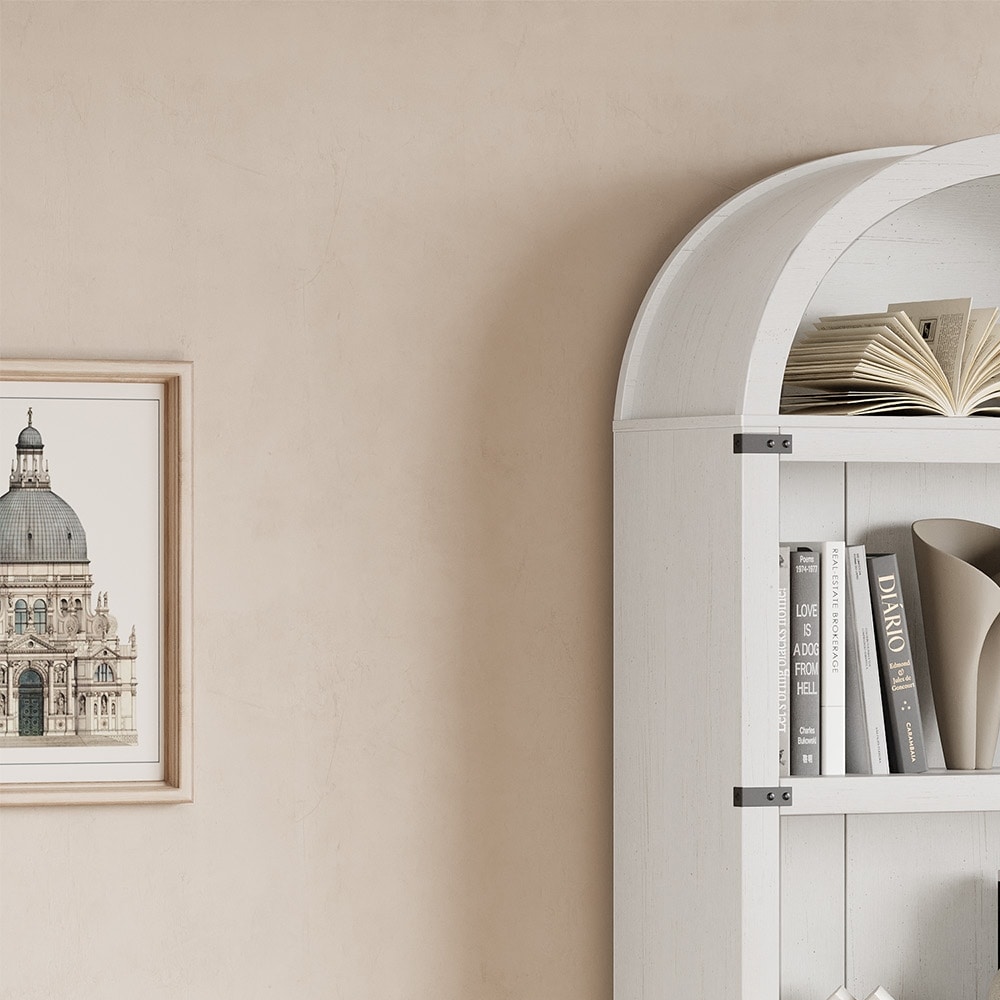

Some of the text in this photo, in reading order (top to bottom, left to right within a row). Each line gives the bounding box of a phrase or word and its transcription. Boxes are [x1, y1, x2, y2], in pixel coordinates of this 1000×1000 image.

[796, 604, 818, 618] LOVE
[878, 574, 906, 653] DIÁRIO
[803, 623, 812, 636] IS
[793, 642, 820, 656] A DOG
[831, 612, 839, 673] BROKERAGE
[795, 662, 819, 676] FROM
[796, 682, 818, 695] HELL
